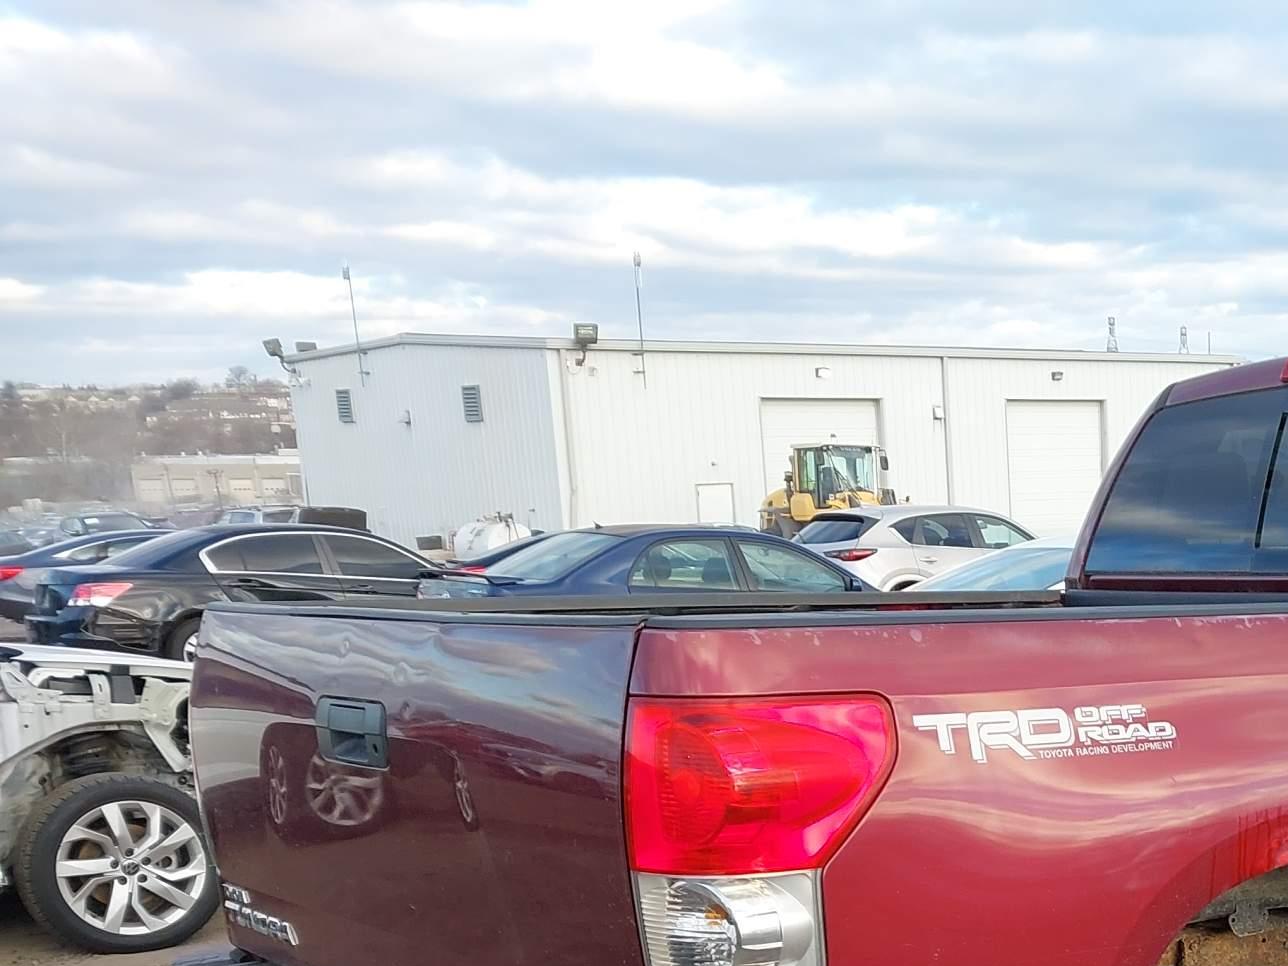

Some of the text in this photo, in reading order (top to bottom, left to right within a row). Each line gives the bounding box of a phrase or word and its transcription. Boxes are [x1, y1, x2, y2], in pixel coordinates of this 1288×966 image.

[1073, 704, 1147, 725] OFF
[912, 707, 1075, 764] TRD
[1077, 721, 1178, 745] ROAD
[1039, 740, 1174, 760] TOYOTA RACING DEVELOPMENT
